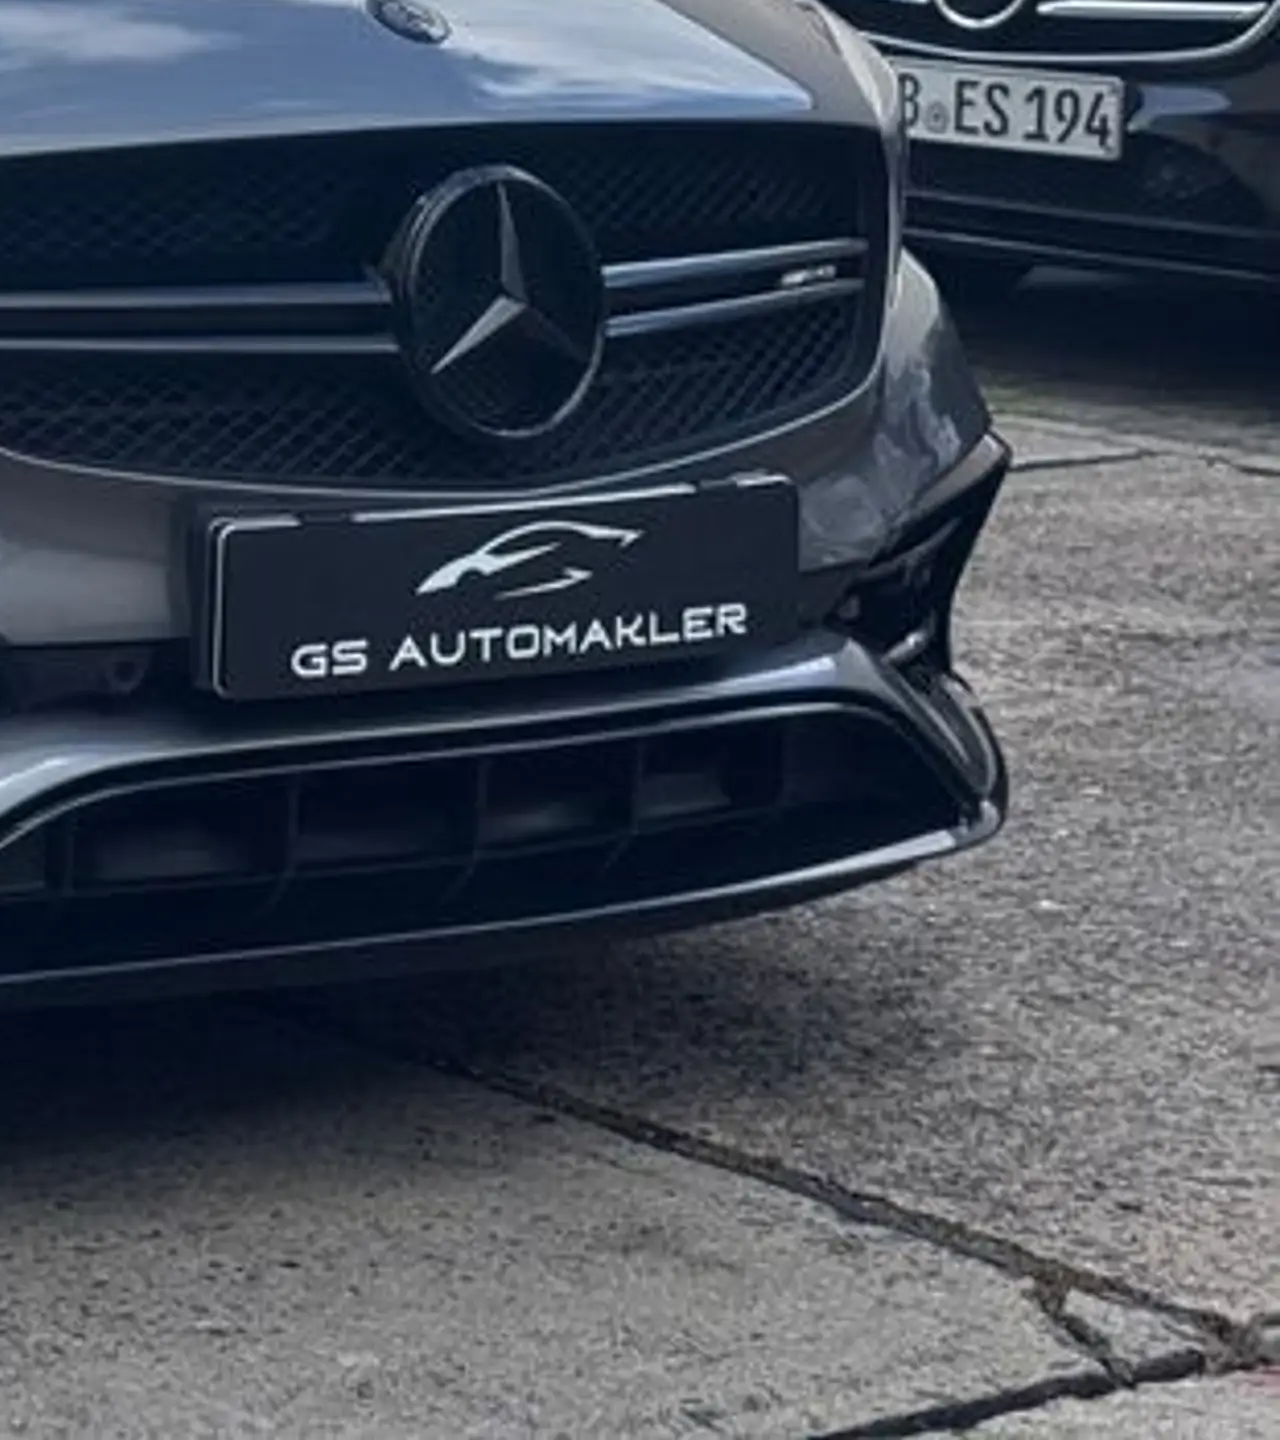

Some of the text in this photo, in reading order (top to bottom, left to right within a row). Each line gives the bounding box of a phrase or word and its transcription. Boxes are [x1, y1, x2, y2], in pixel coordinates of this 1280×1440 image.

[897, 72, 1112, 148] B ES 194
[291, 602, 748, 678] GS AUTOMAKLER
